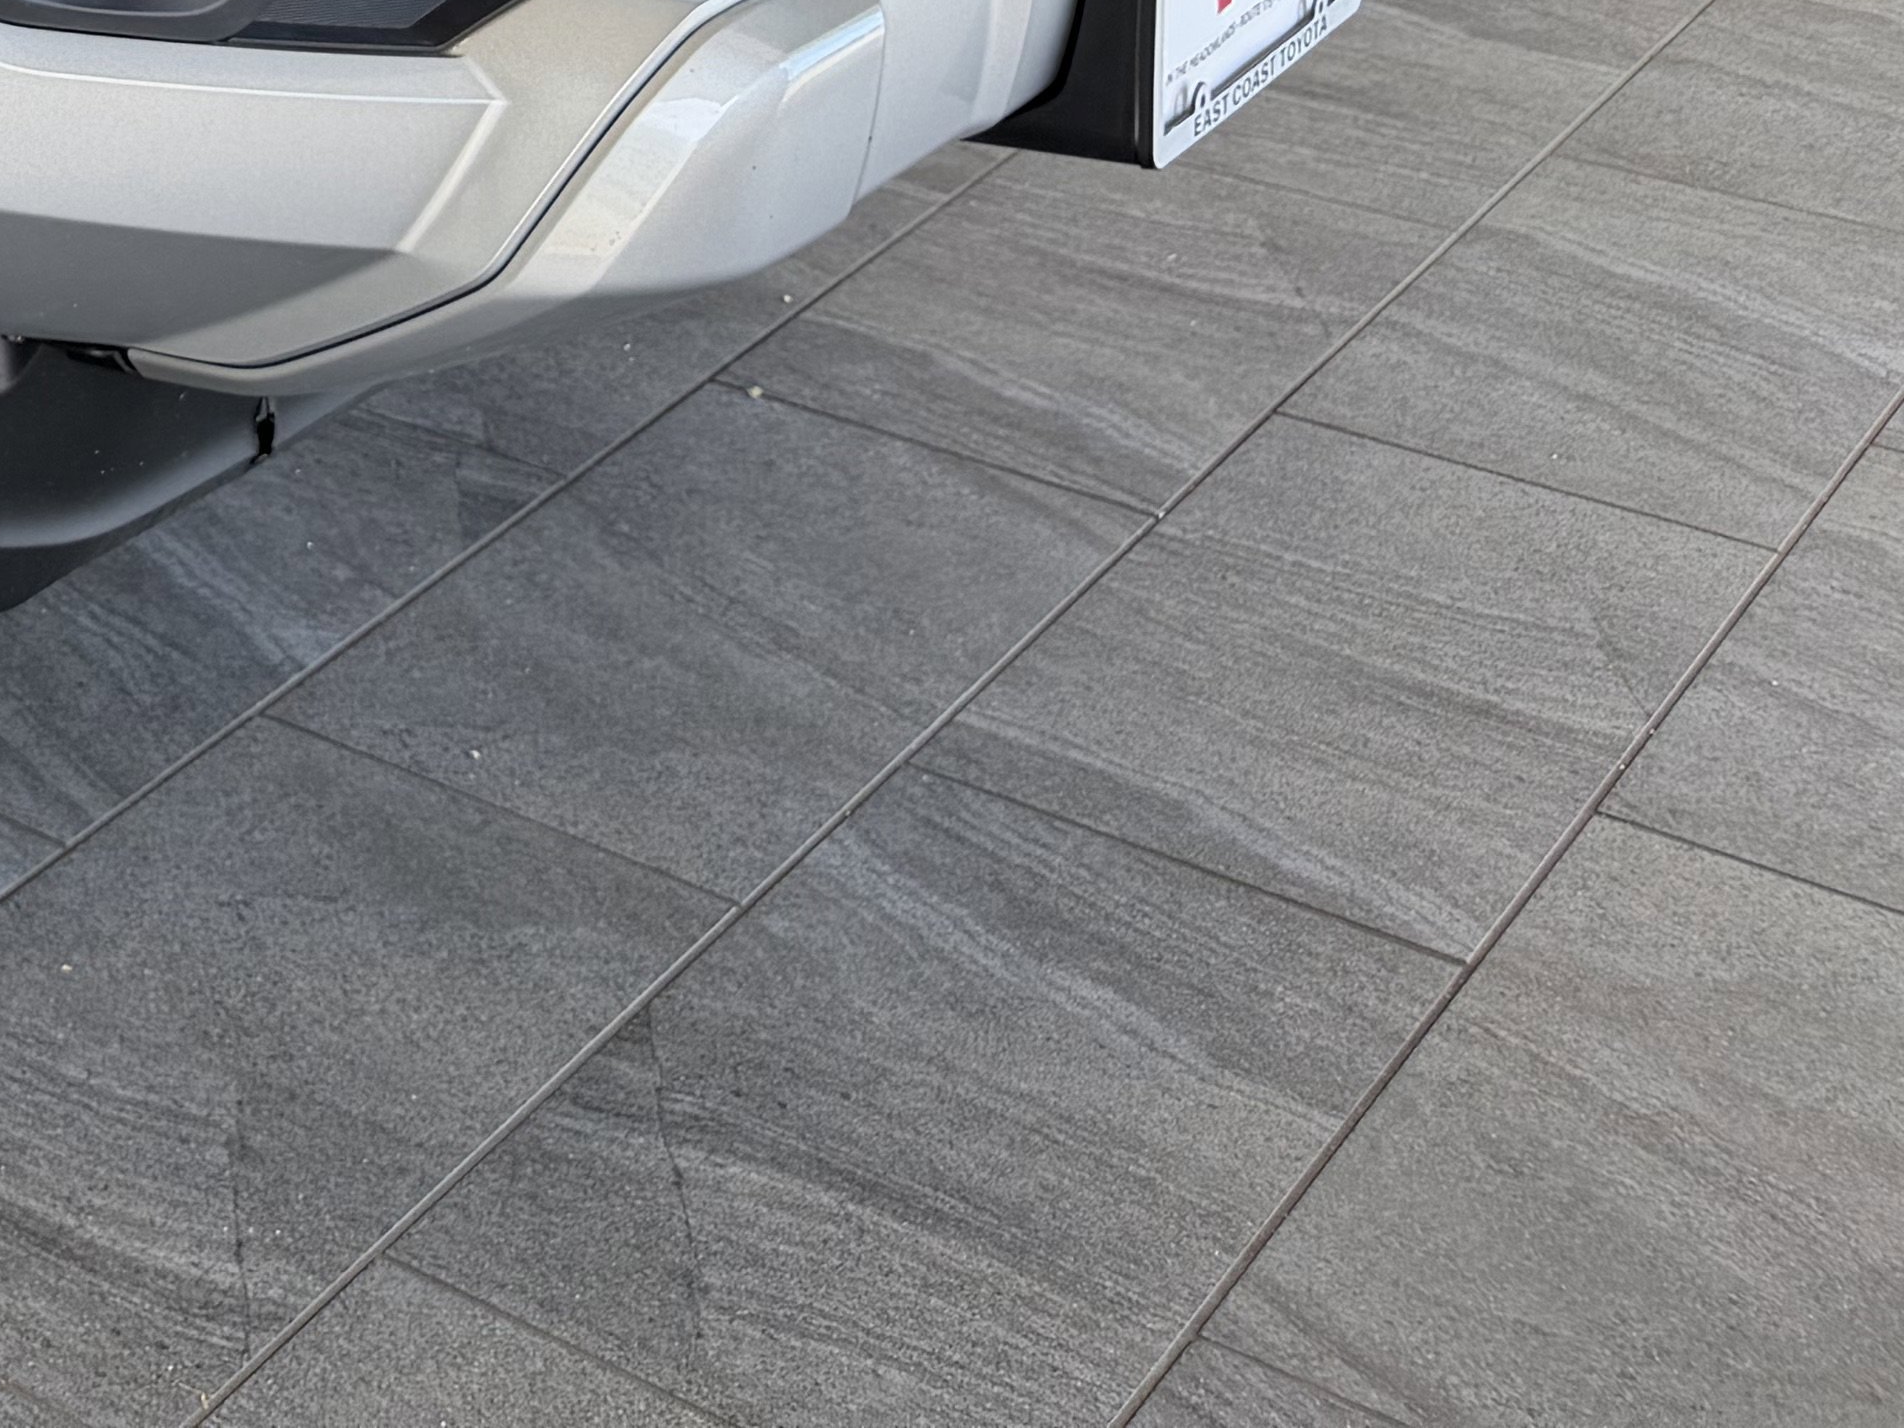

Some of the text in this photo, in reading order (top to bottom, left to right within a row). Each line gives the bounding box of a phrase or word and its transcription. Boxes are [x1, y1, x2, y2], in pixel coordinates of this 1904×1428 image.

[1193, 15, 1328, 137] EAST COAST TOYOTA
